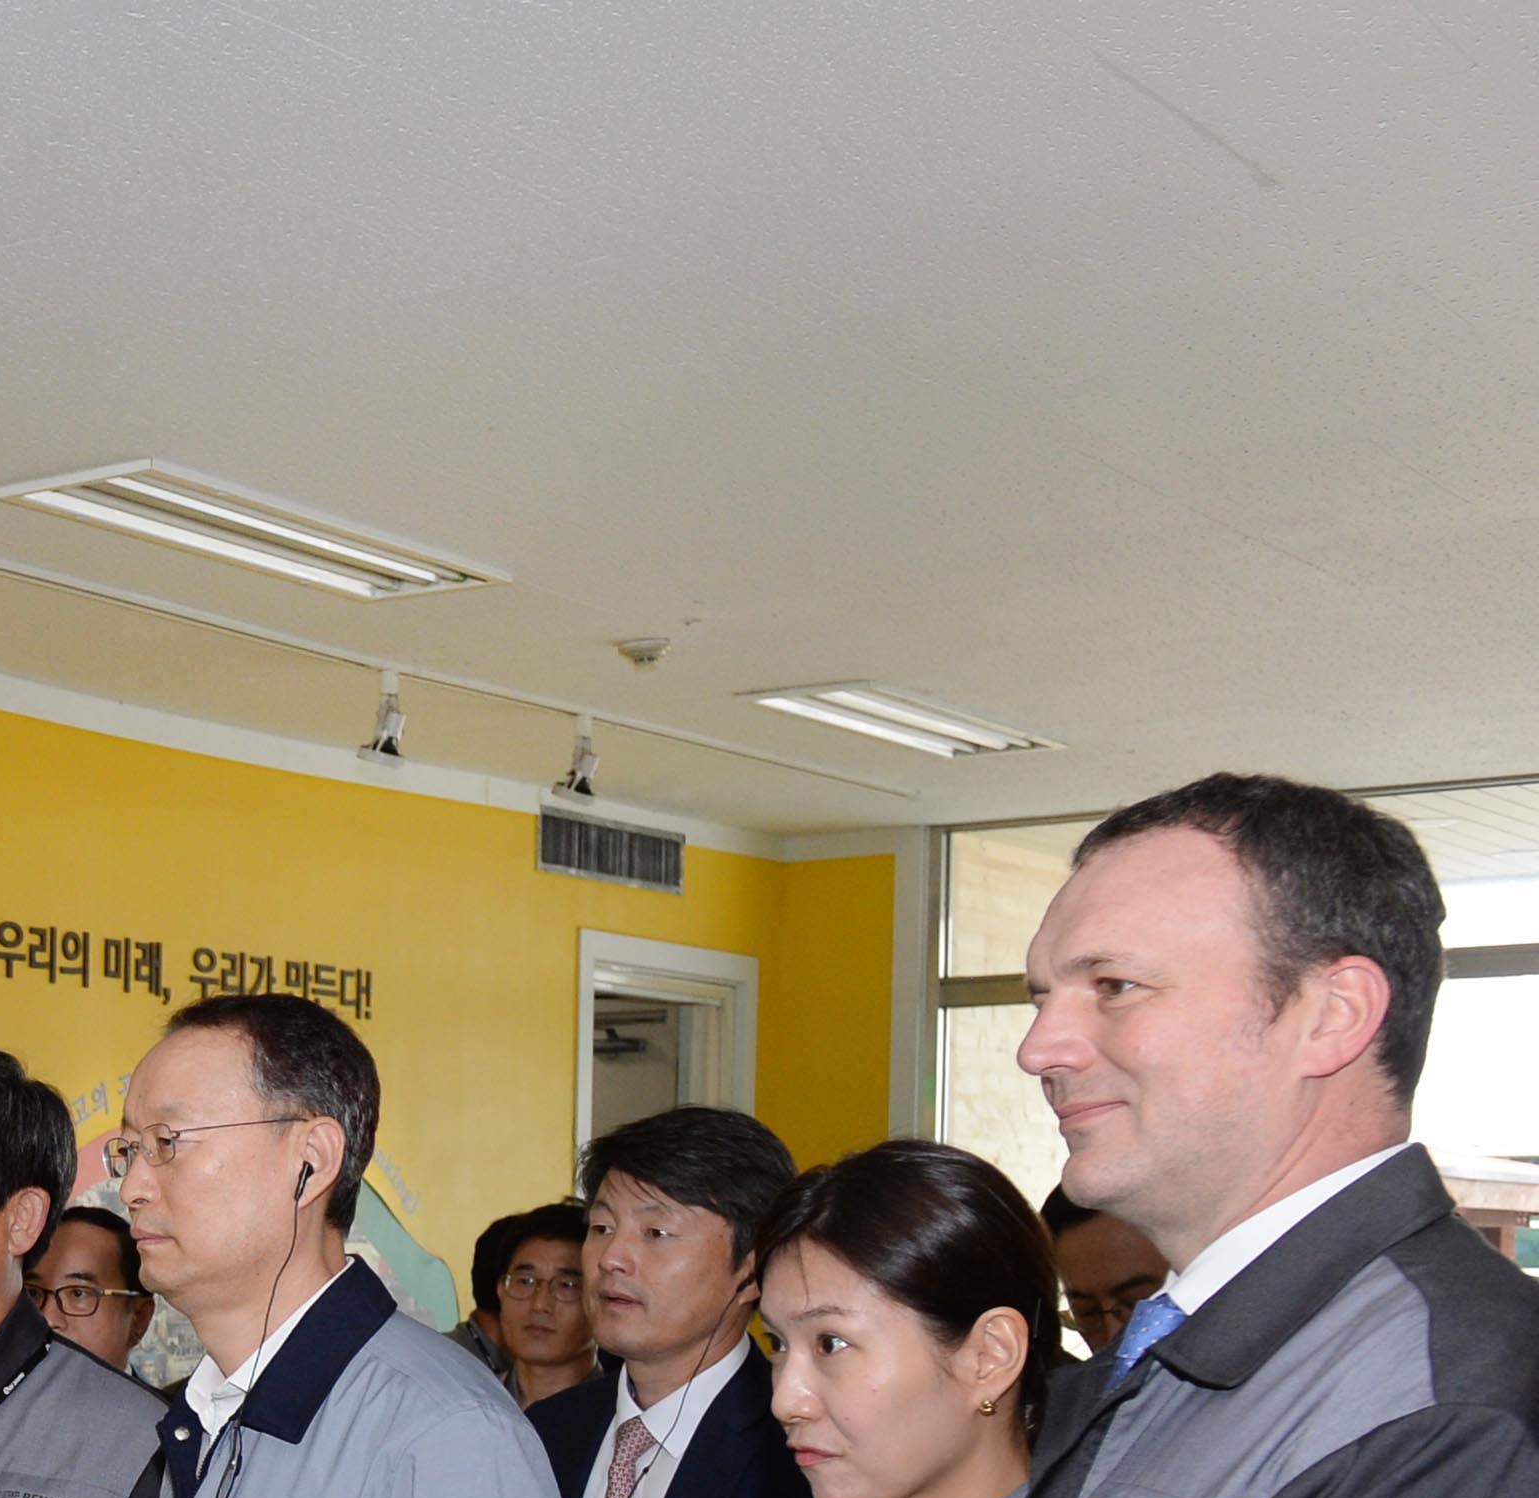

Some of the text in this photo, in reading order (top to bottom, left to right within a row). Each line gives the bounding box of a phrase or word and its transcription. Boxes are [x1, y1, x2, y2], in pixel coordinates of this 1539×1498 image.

[104, 938, 172, 1005] 미래,
[190, 947, 275, 998] 우리가
[285, 959, 373, 1019] 만든다!
